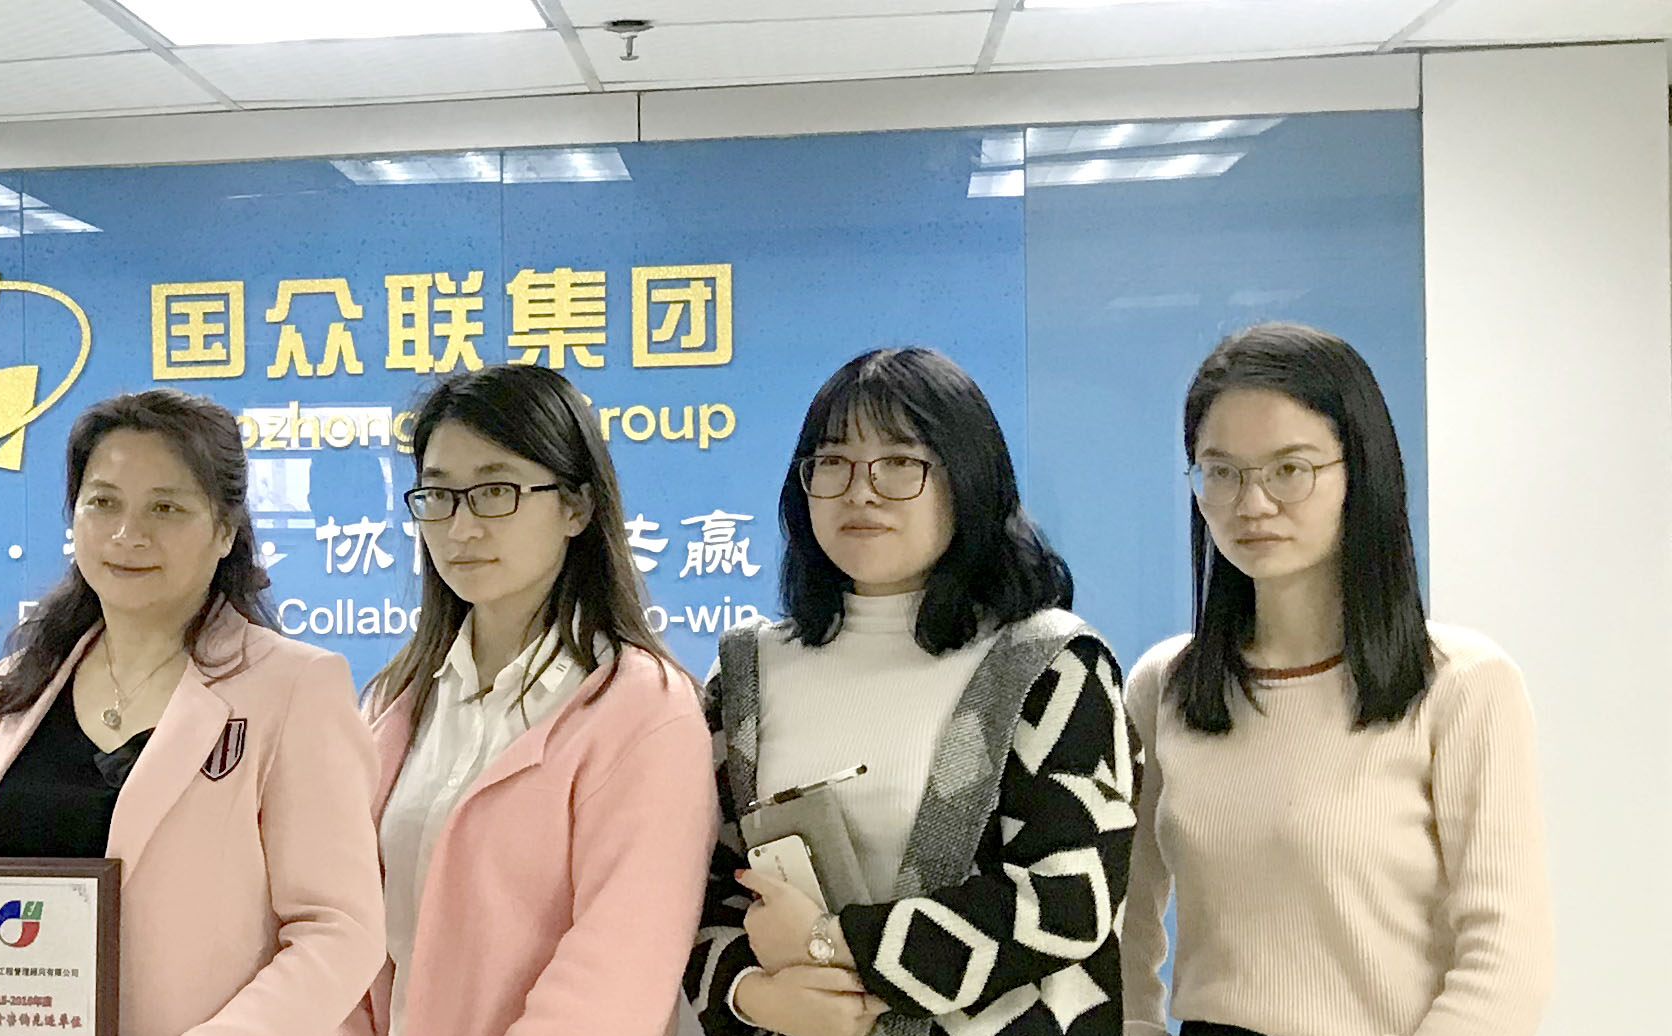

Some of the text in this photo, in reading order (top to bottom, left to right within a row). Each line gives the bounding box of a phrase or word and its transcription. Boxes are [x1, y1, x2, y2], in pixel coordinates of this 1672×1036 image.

[152, 263, 733, 381] 国众联集团
[582, 393, 736, 449] roup
